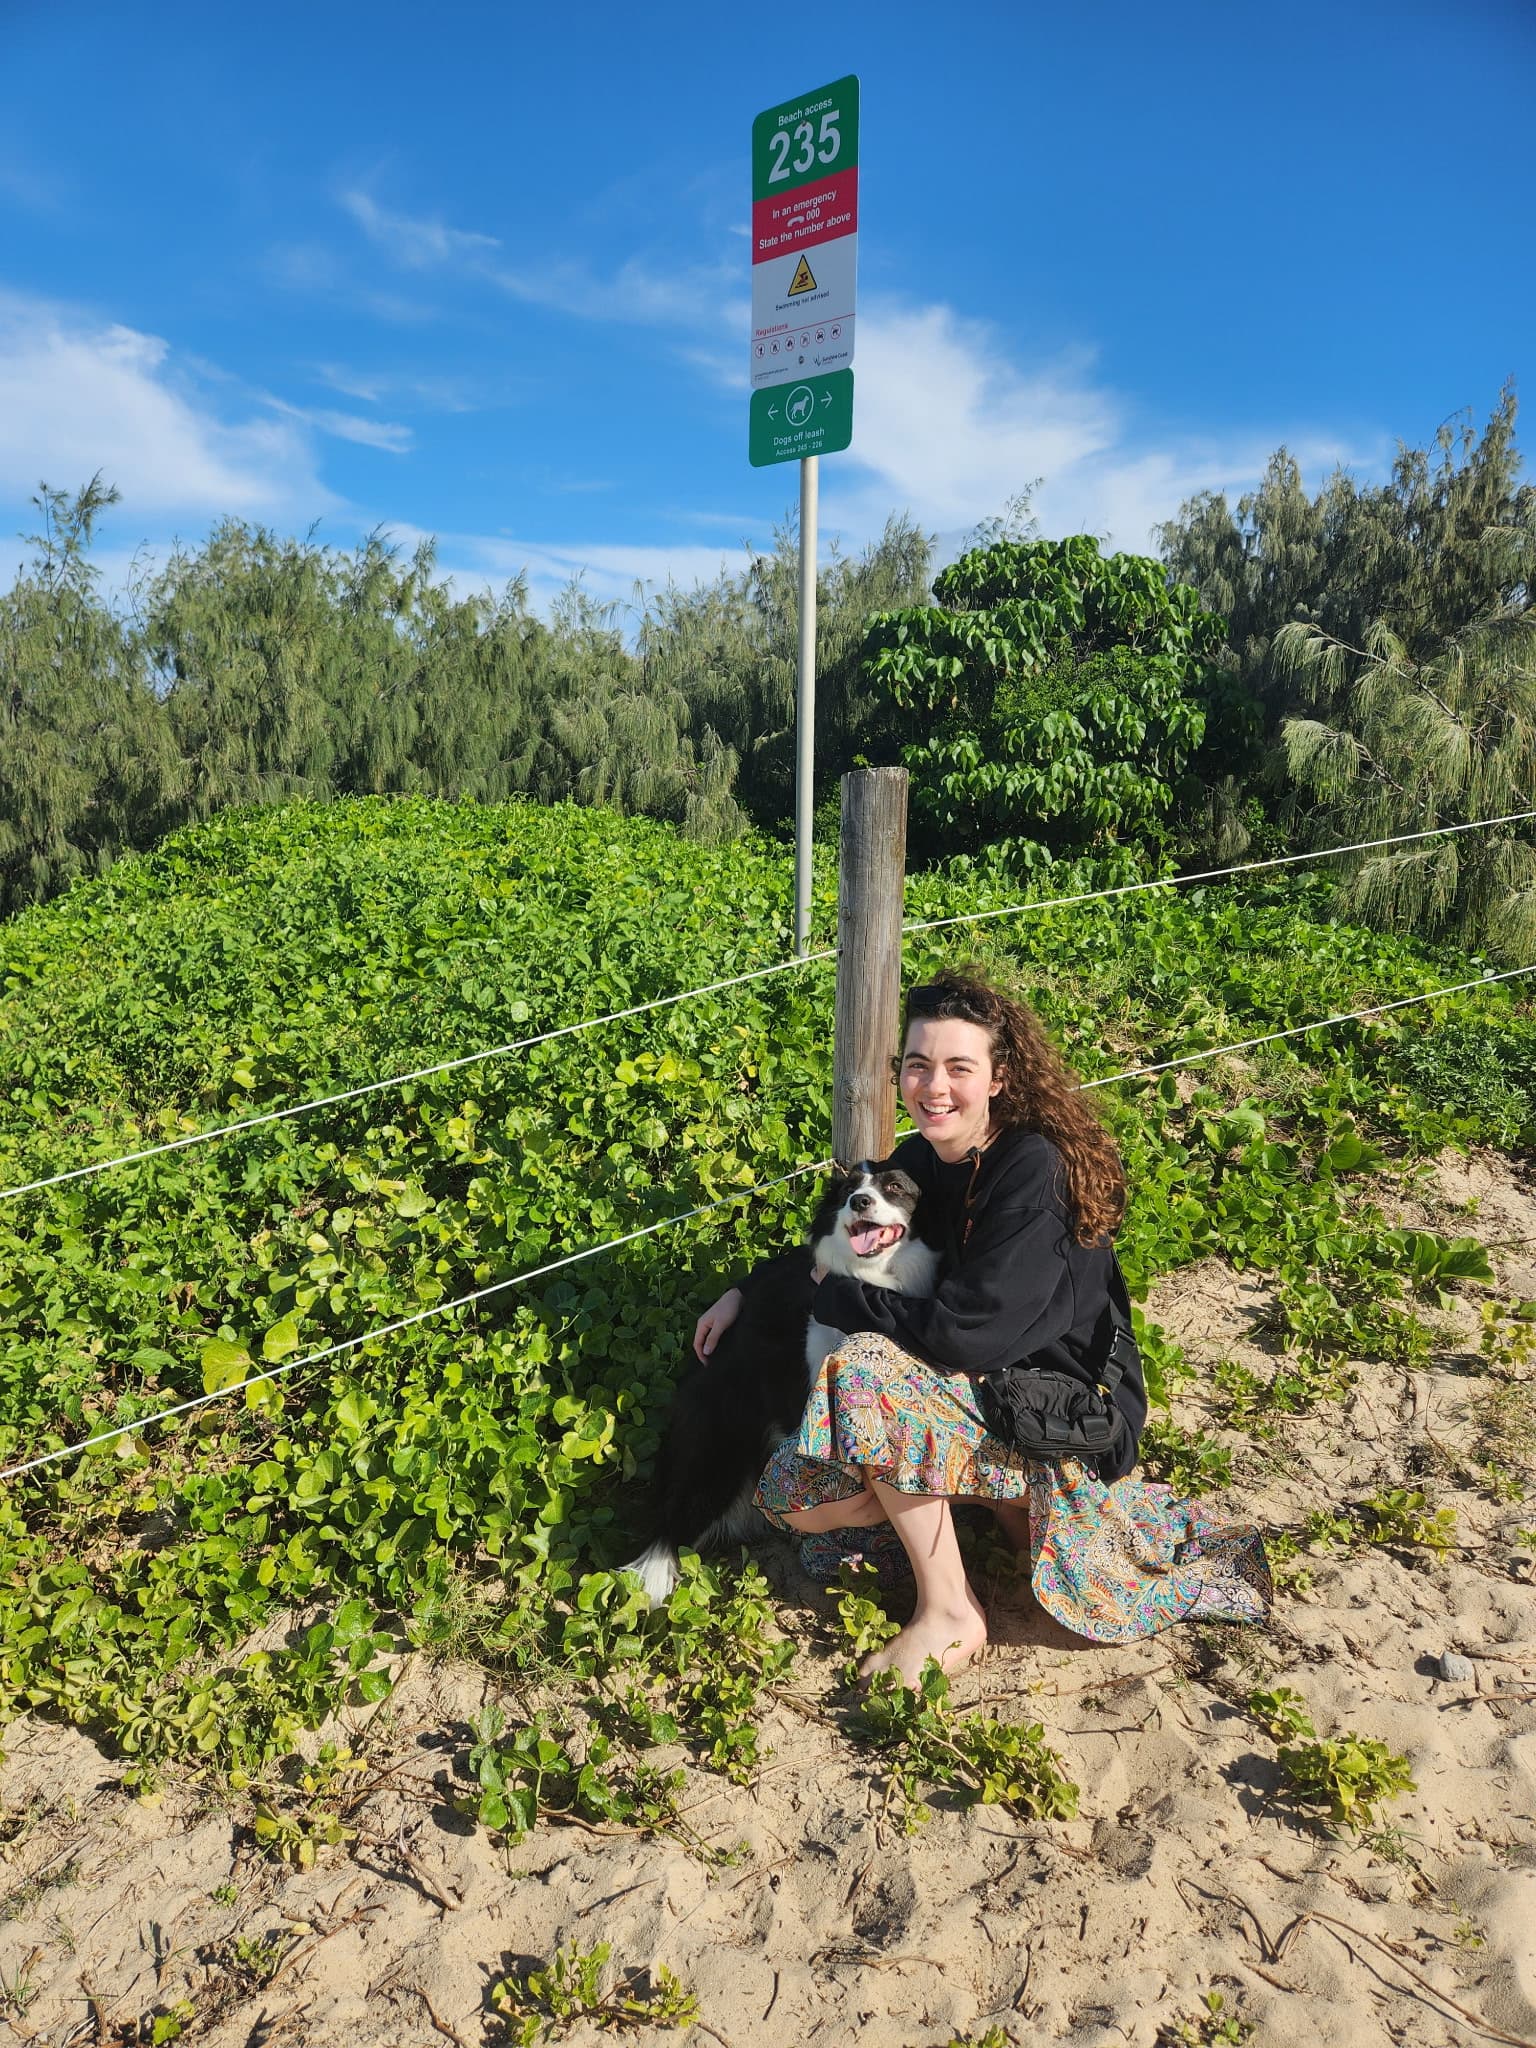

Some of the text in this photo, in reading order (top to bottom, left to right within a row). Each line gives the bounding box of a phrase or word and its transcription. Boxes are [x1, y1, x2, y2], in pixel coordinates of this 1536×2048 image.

[778, 97, 833, 127] Beach access
[768, 109, 841, 185] 235
[772, 190, 837, 219] In an emergency
[806, 207, 821, 221] 000
[759, 212, 851, 249] State the number above
[755, 322, 789, 336] Regulations
[773, 426, 825, 446] Dogs off leash
[775, 447, 796, 457] Access
